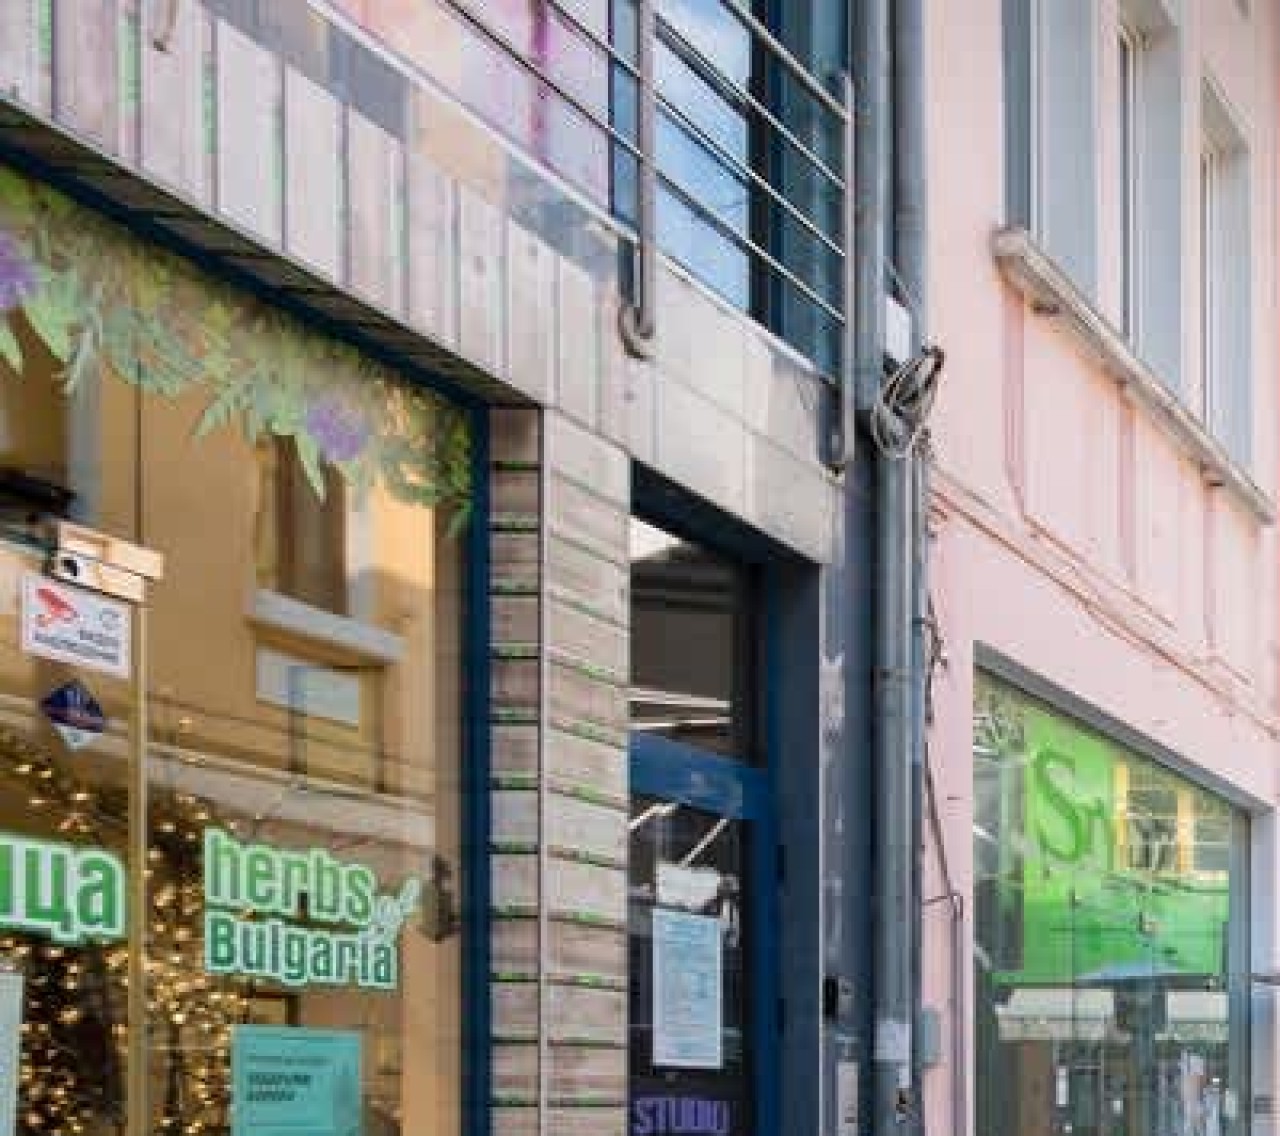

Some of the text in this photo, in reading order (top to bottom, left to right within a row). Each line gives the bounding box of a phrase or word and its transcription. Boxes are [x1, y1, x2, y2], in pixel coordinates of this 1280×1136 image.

[207, 831, 373, 924] herbs
[209, 914, 395, 985] Bulgaria
[634, 1097, 730, 1136] STUDIO
